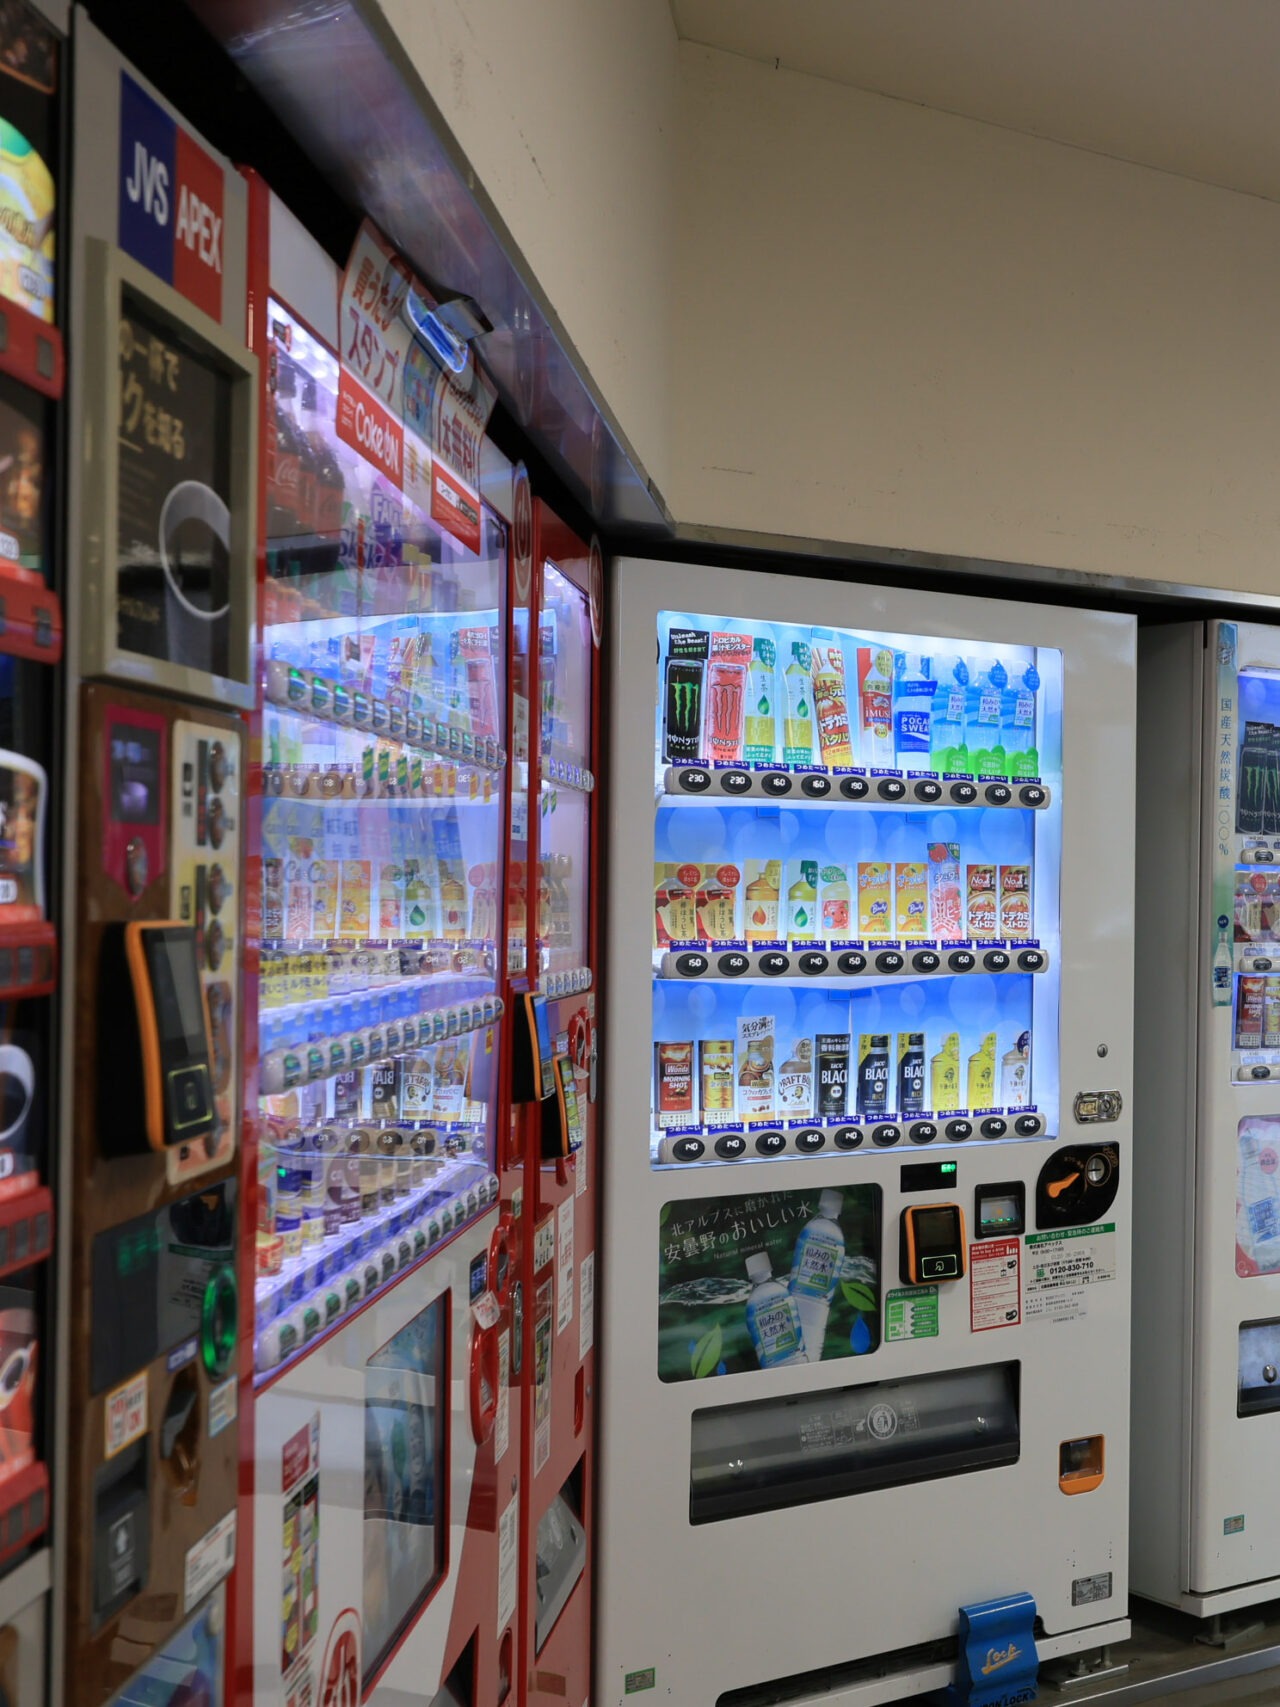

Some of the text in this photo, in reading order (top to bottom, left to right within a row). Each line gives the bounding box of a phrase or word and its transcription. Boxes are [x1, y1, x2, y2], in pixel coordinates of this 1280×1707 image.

[126, 141, 222, 274] JVS APEX
[865, 707, 892, 718] iMUS
[819, 715, 849, 730] ドデカミ
[901, 724, 930, 733] SWEA
[688, 773, 705, 783] 230
[729, 775, 746, 785] 230
[773, 777, 786, 787] 160
[812, 779, 825, 789] 160
[850, 781, 863, 790] 190
[888, 783, 900, 792] 180
[924, 785, 936, 794] 180
[968, 911, 997, 922] ドデカミ
[1002, 911, 1029, 922] ドデカミ
[973, 919, 997, 929] ストロン
[1006, 919, 1029, 929] ストロン
[688, 958, 702, 967] 150
[730, 957, 743, 967] 150
[770, 957, 783, 966] 140
[810, 957, 823, 966] 140
[848, 956, 861, 965] 150
[886, 956, 898, 965] 150
[922, 955, 934, 964] 150
[845, 1131, 858, 1140] 140
[882, 1128, 895, 1137] 170
[919, 1126, 931, 1135] 170
[767, 1136, 780, 1145] 170
[806, 1133, 819, 1143] 160
[685, 1142, 699, 1151] 140
[726, 1139, 740, 1148] 140
[671, 1191, 793, 1237] 北アルプスに磨かれた
[664, 1200, 813, 1264] 安曇野のおいしい水
[1049, 1261, 1094, 1275] 0120-830-710
[981, 1643, 1023, 1675] Lock
